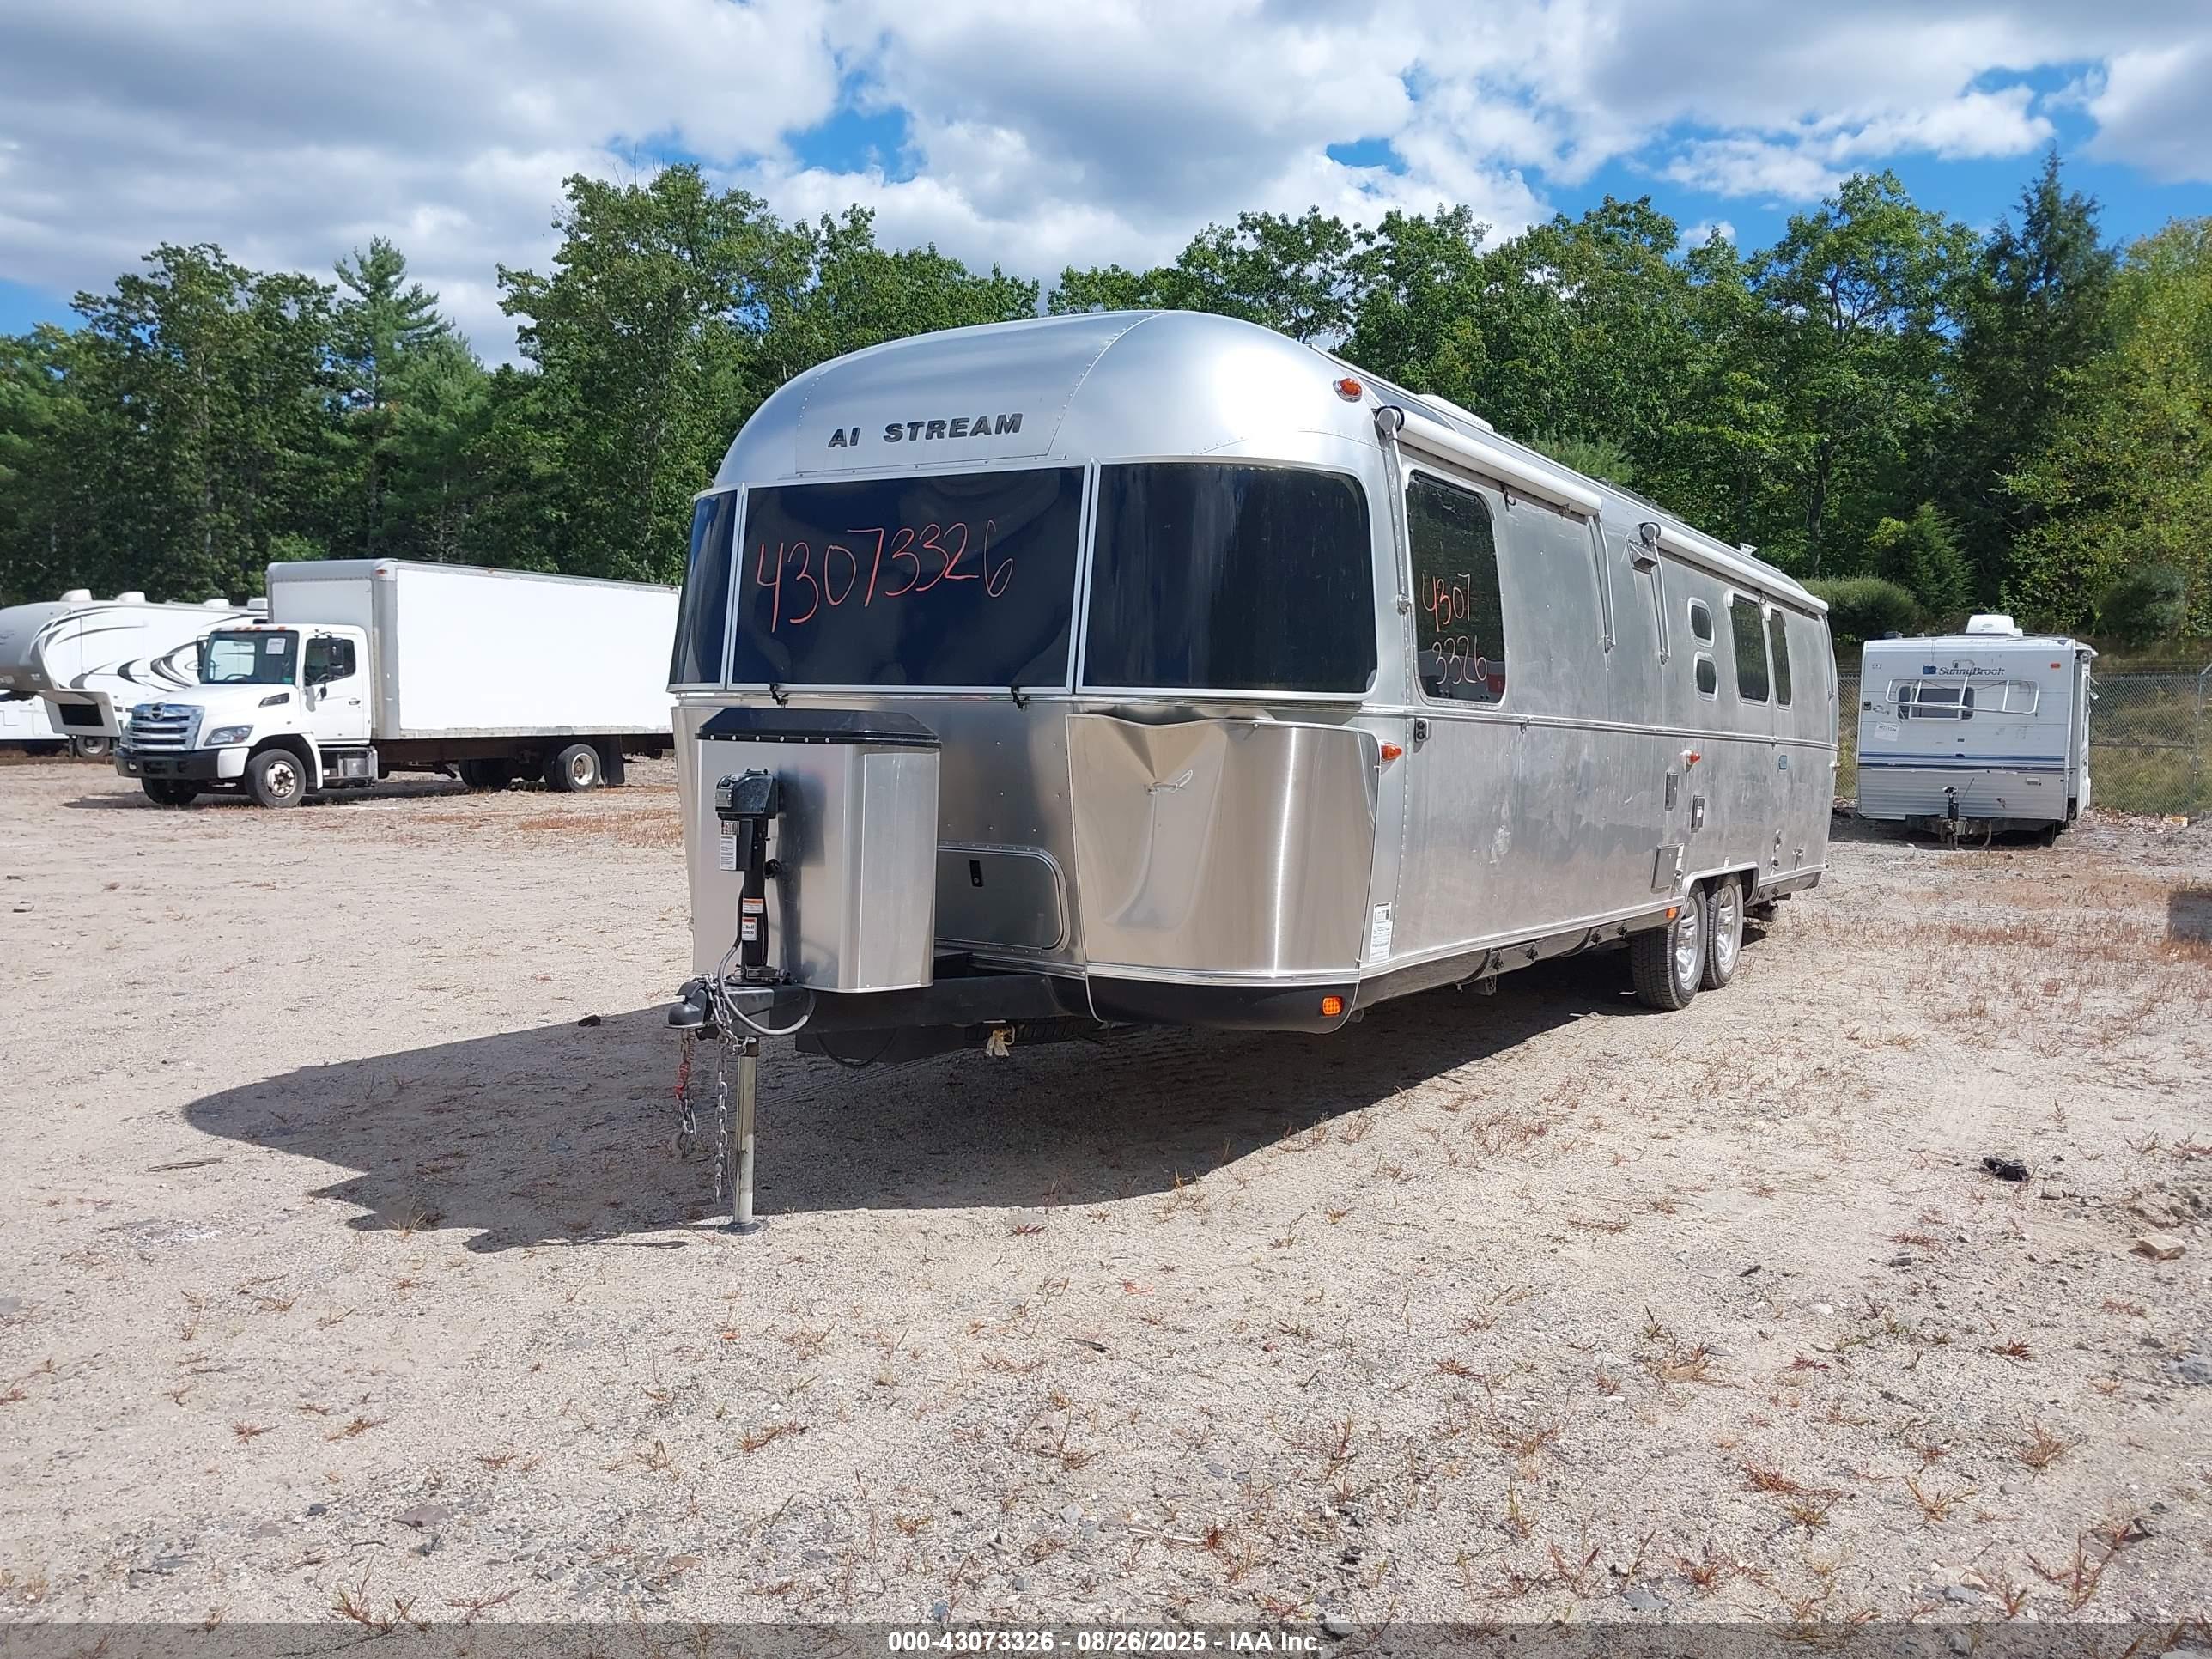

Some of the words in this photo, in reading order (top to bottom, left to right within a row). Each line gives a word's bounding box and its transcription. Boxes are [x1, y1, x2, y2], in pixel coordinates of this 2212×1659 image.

[827, 427, 861, 448] AI
[882, 413, 1024, 443] STREAM
[757, 520, 1014, 633] 43073326
[1422, 573, 1471, 633] 4307
[1431, 635, 1488, 684] 3326
[1938, 666, 2006, 678] SunnyBrook
